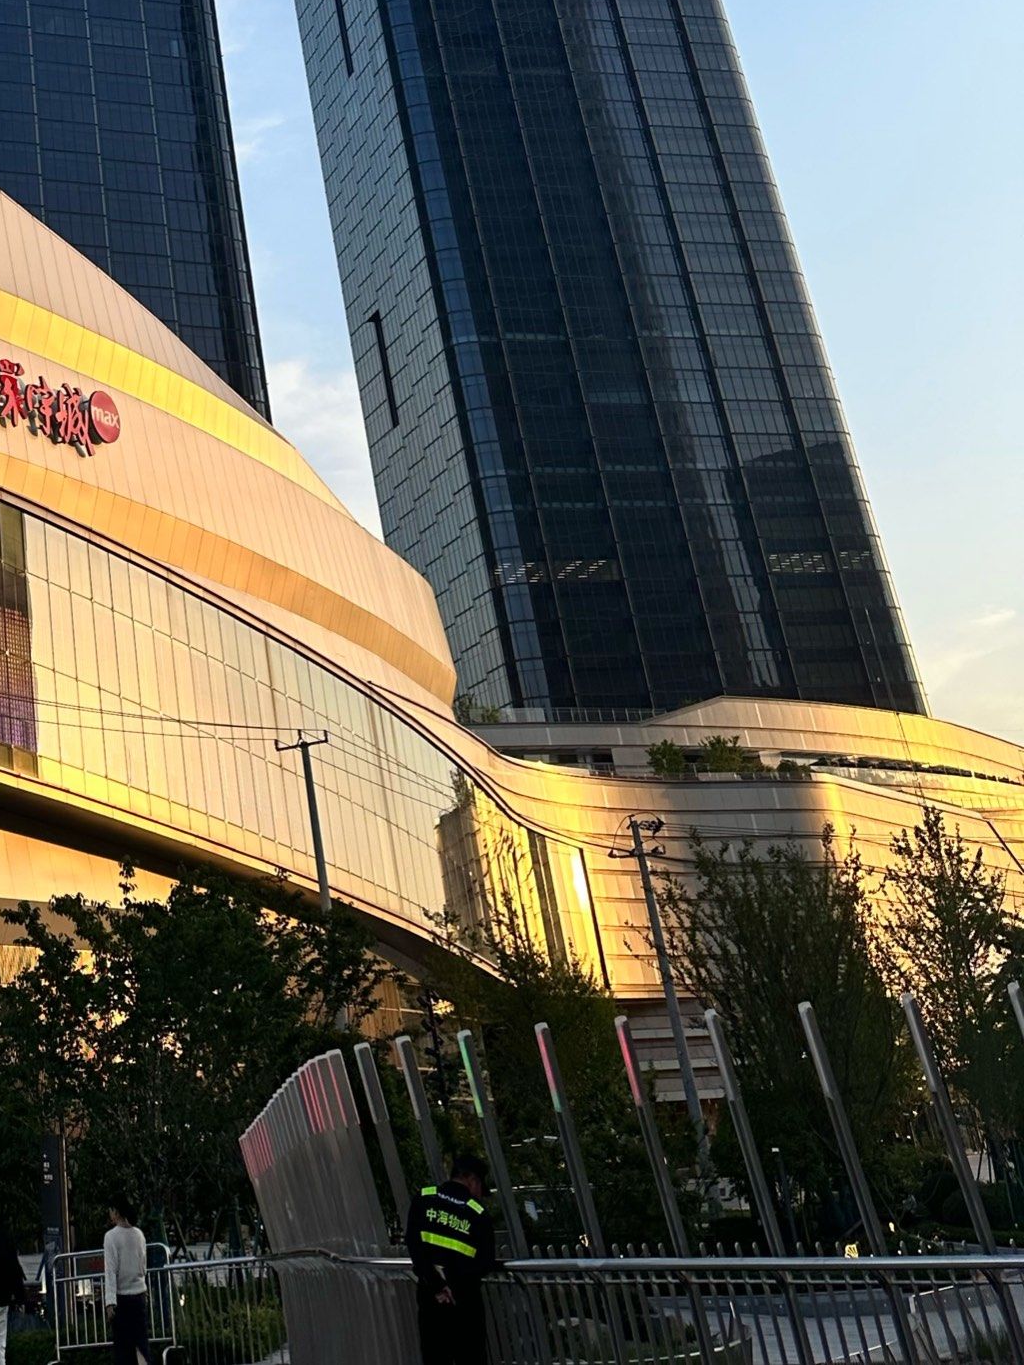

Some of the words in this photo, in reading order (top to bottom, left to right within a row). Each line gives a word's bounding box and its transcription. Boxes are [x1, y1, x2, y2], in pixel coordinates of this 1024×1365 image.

[90, 405, 120, 430] max
[426, 1208, 471, 1234] 中海物业
